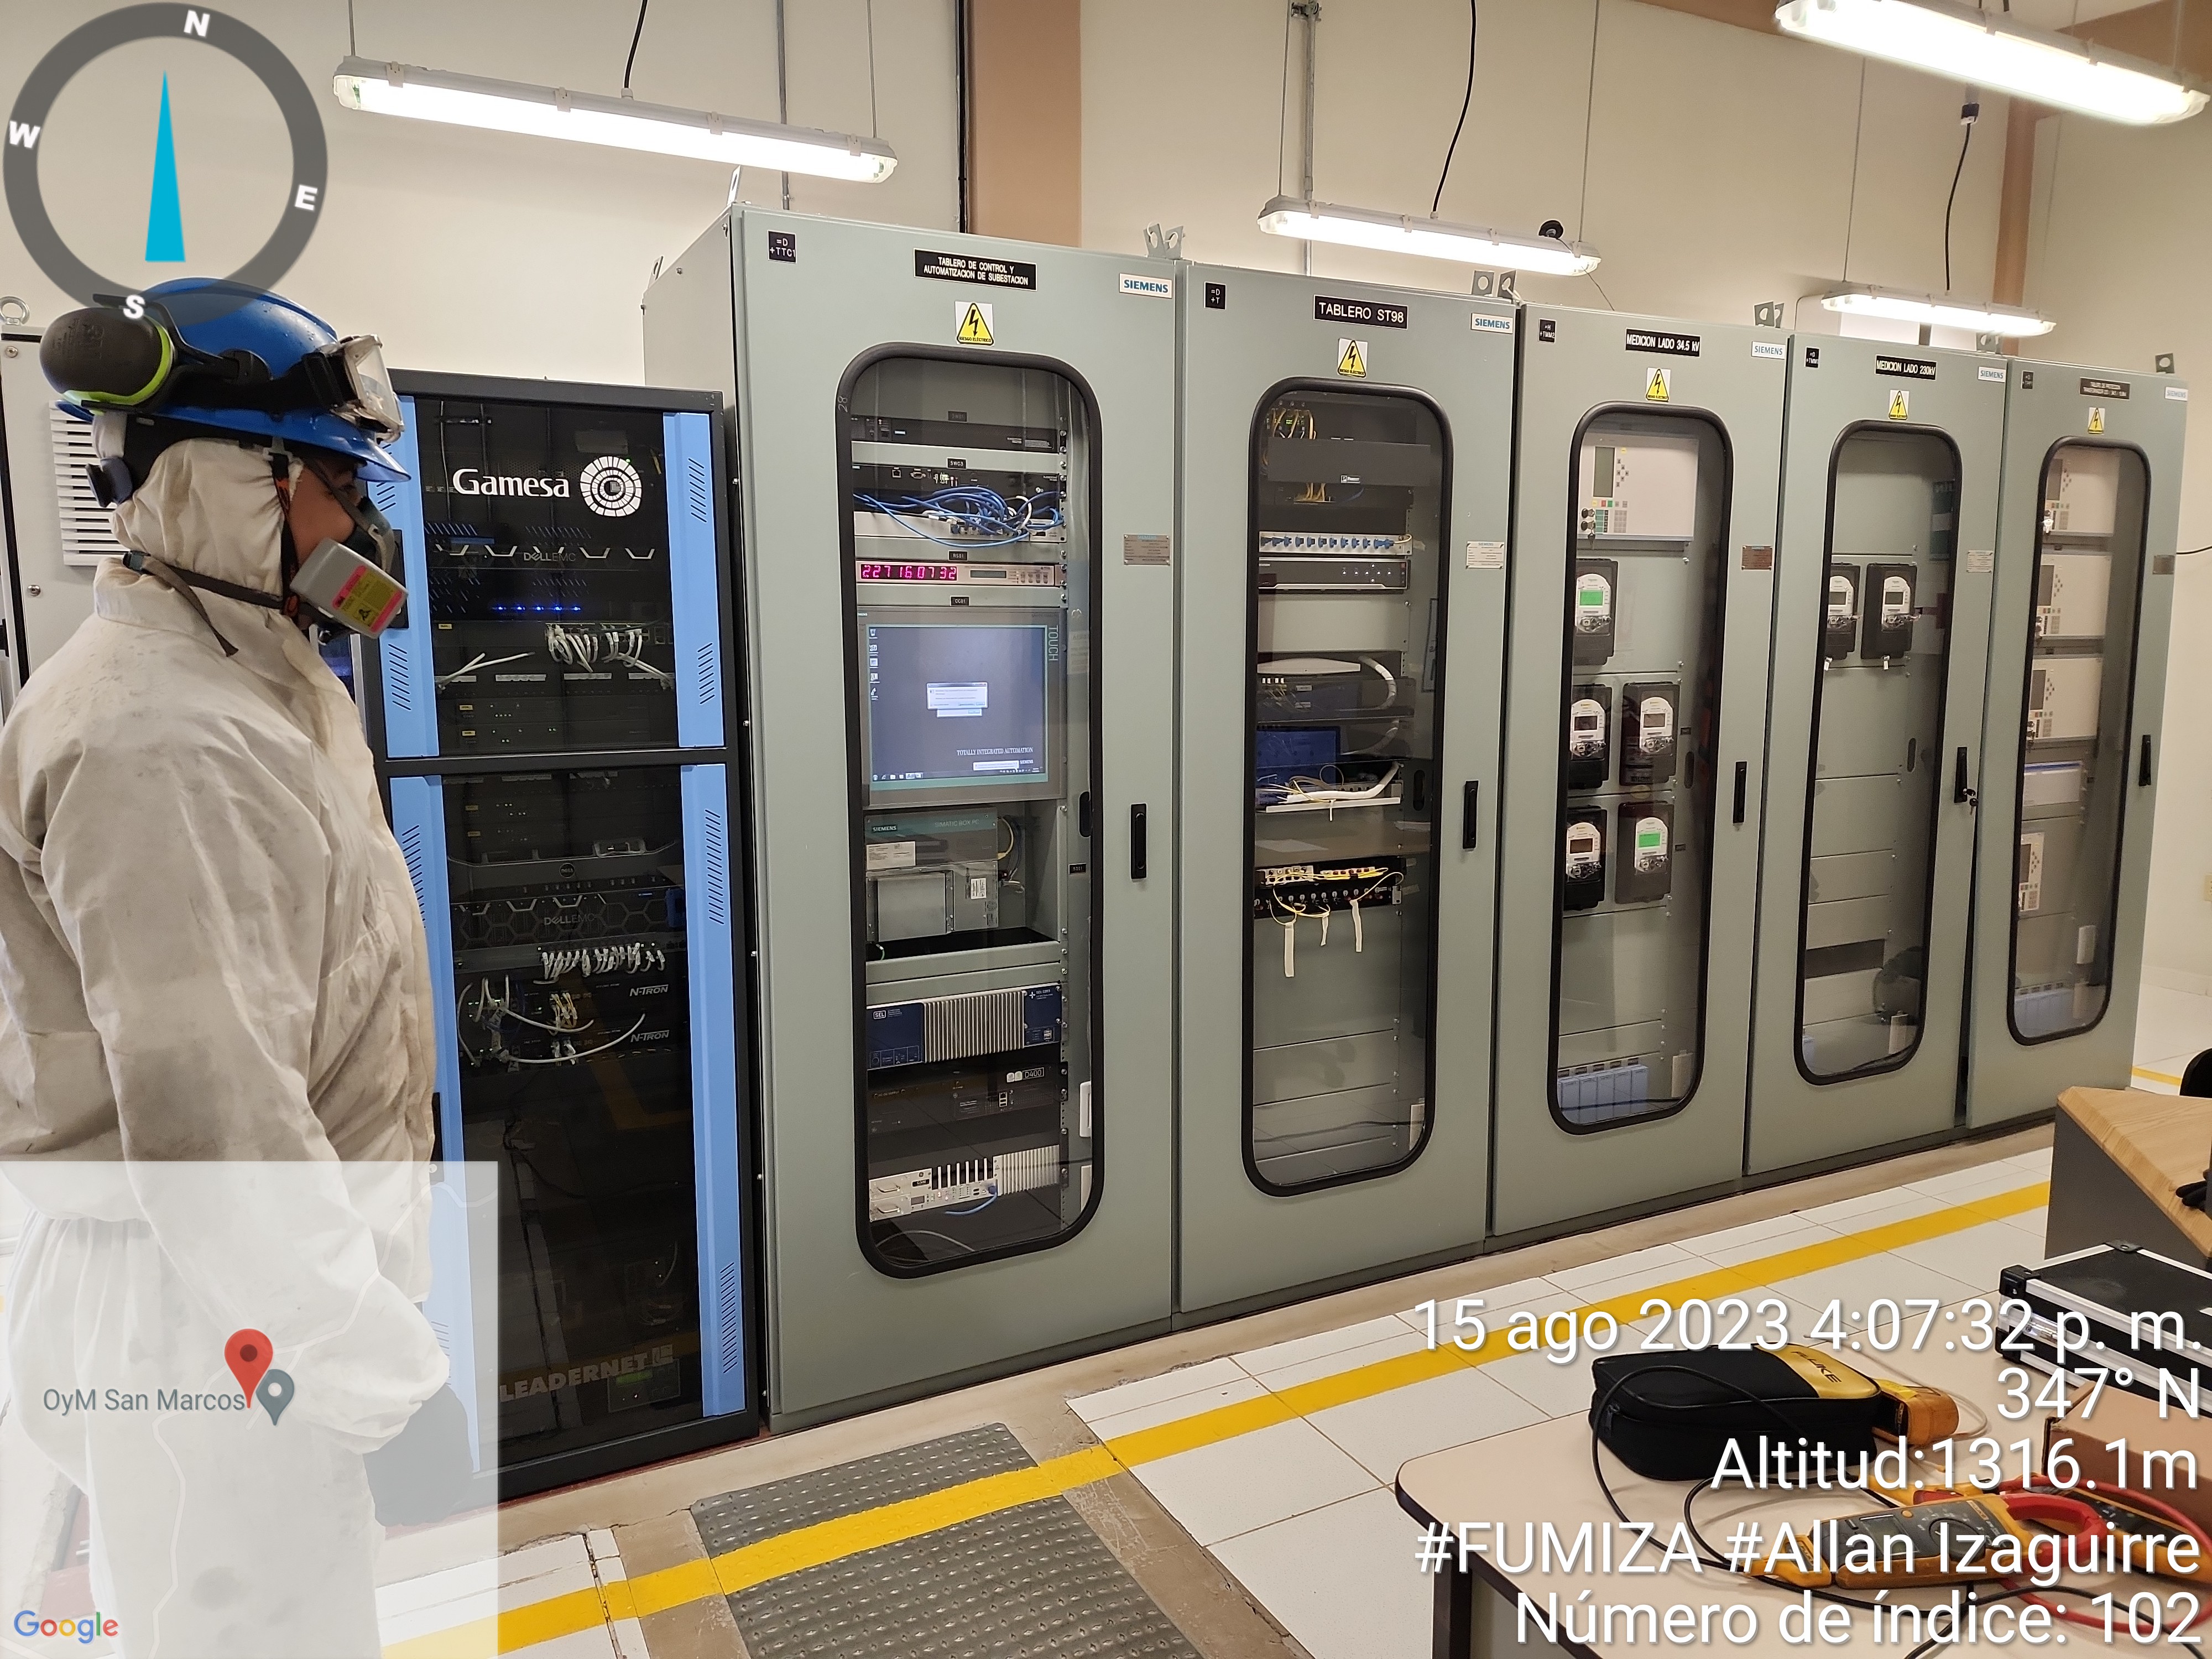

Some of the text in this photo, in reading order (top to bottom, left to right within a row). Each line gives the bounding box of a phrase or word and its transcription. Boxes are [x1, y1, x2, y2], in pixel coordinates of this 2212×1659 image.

[776, 238, 788, 247] =D
[769, 247, 795, 258] +TTC1
[938, 256, 1014, 274] TABLERO DE CONTROL Y
[924, 264, 1029, 285] AUTOMATIZACION DE SUBESTACION
[1124, 279, 1168, 293] SIEMENS
[1211, 296, 1220, 305] +T
[1319, 302, 1405, 324] TABLERO ST98
[1474, 317, 1511, 330] SIEMENS
[1626, 333, 1656, 348] MEDICION
[1658, 337, 1675, 349] LADO
[1676, 339, 1690, 352] 34.5
[1754, 345, 1783, 356] SIEMENS
[1876, 359, 1936, 376] MEDICION LADO 230kV
[1980, 370, 2004, 379] SIEMENS
[2167, 389, 2187, 398] SIEMENS
[837, 395, 848, 413] 28
[452, 468, 570, 498] Gamesa
[1048, 624, 1058, 661] TOUCH
[629, 984, 669, 997] N-TRON
[630, 1030, 670, 1043] N-TRON
[1025, 1069, 1042, 1079] D400
[1791, 1351, 1842, 1383] FLUKE
[499, 1353, 648, 1404] LEADERNET
